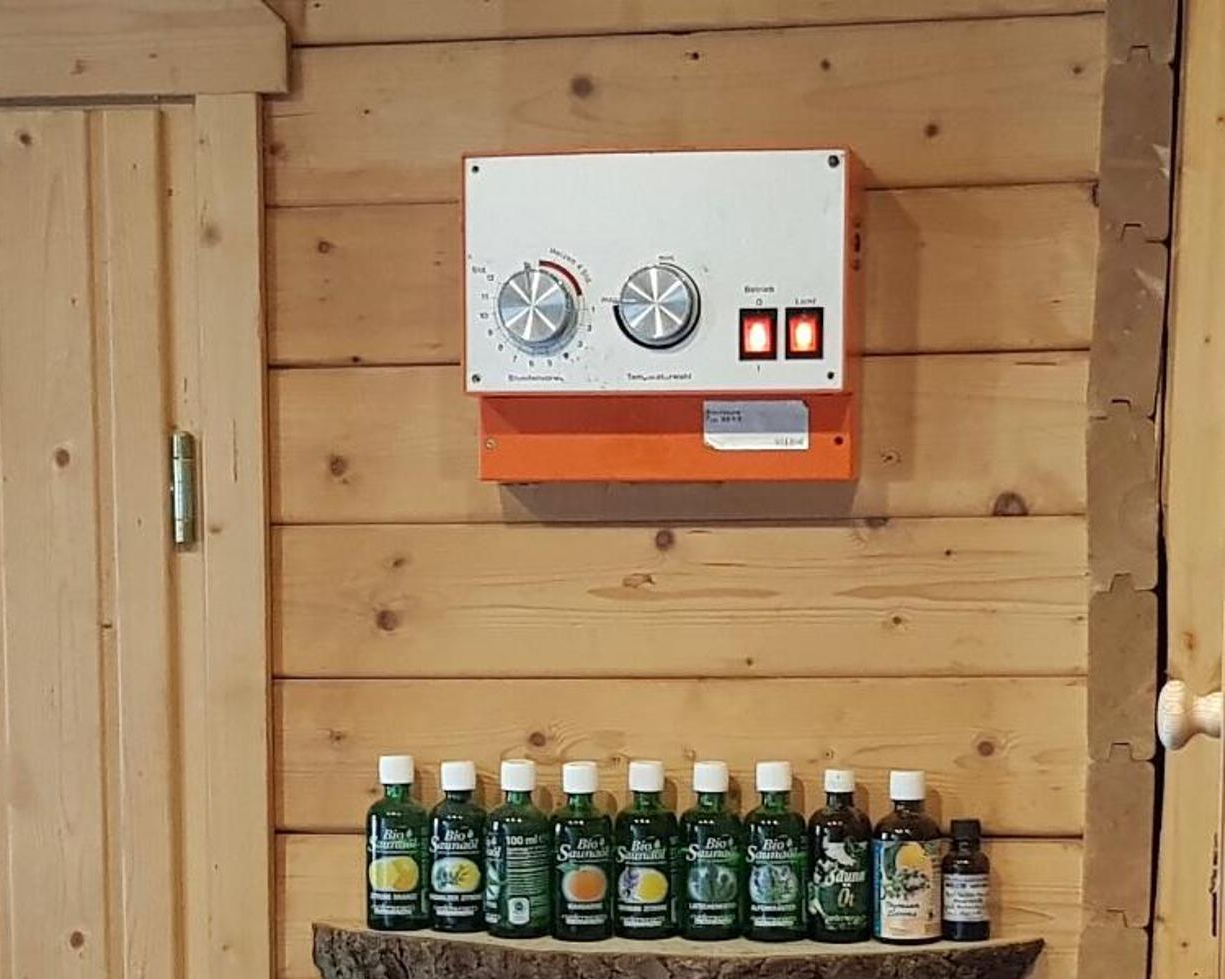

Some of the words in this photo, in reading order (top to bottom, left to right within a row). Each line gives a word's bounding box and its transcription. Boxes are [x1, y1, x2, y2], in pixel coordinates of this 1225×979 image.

[383, 829, 404, 841] Bio
[444, 829, 466, 841] Bio
[506, 835, 524, 846] 100
[429, 835, 480, 852] Saunaöl
[577, 838, 599, 850] Bio
[631, 839, 653, 851] Bio
[705, 838, 727, 850] Bio
[762, 838, 785, 850] Bio
